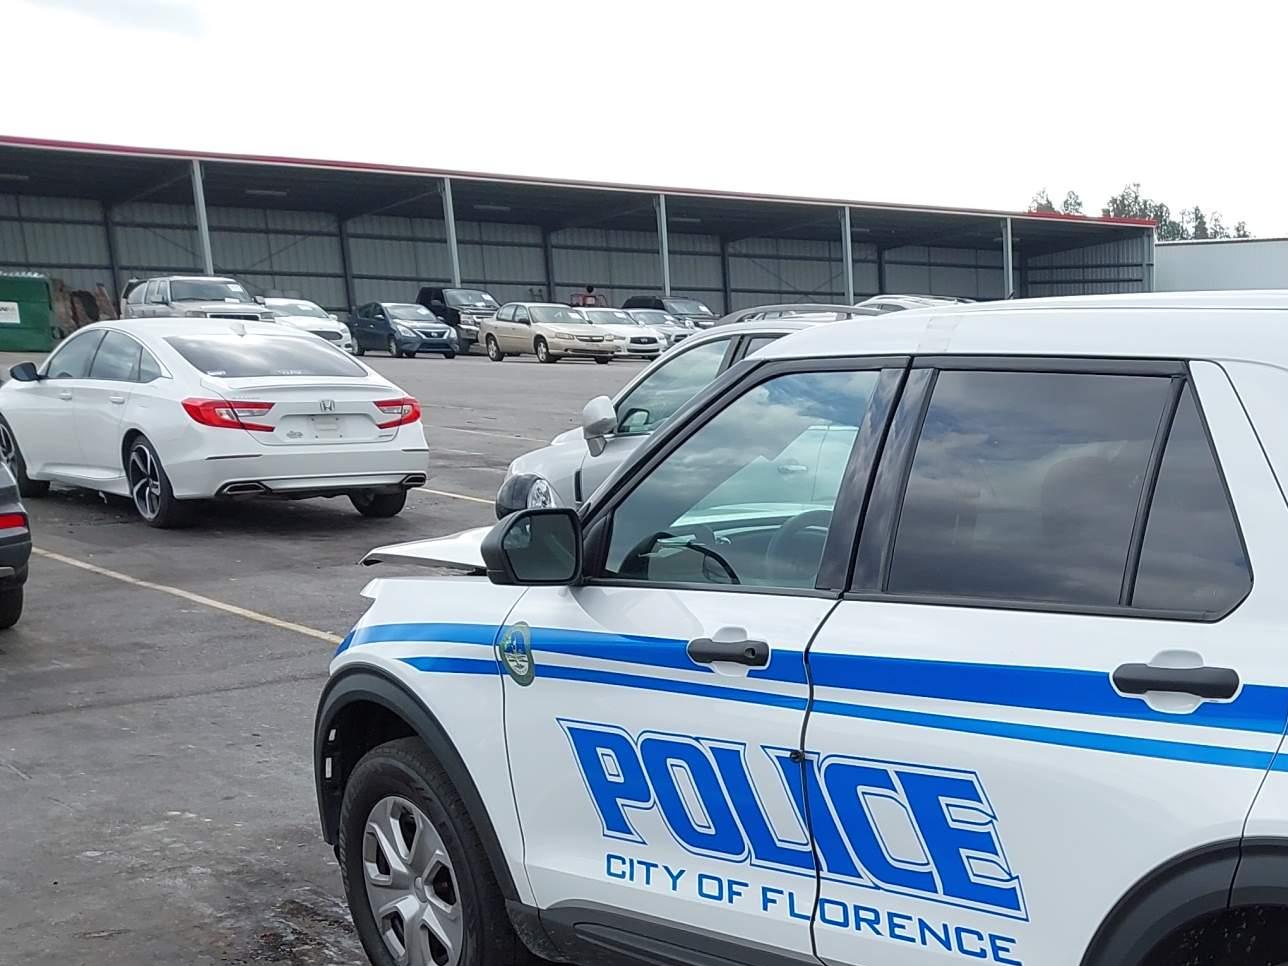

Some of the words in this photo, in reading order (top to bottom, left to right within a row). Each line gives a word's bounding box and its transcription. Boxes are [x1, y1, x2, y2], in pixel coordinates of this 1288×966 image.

[557, 717, 1029, 921] POLICE
[606, 852, 687, 892] CITY
[697, 872, 750, 905] OF
[761, 886, 1023, 966] FLORENCE
